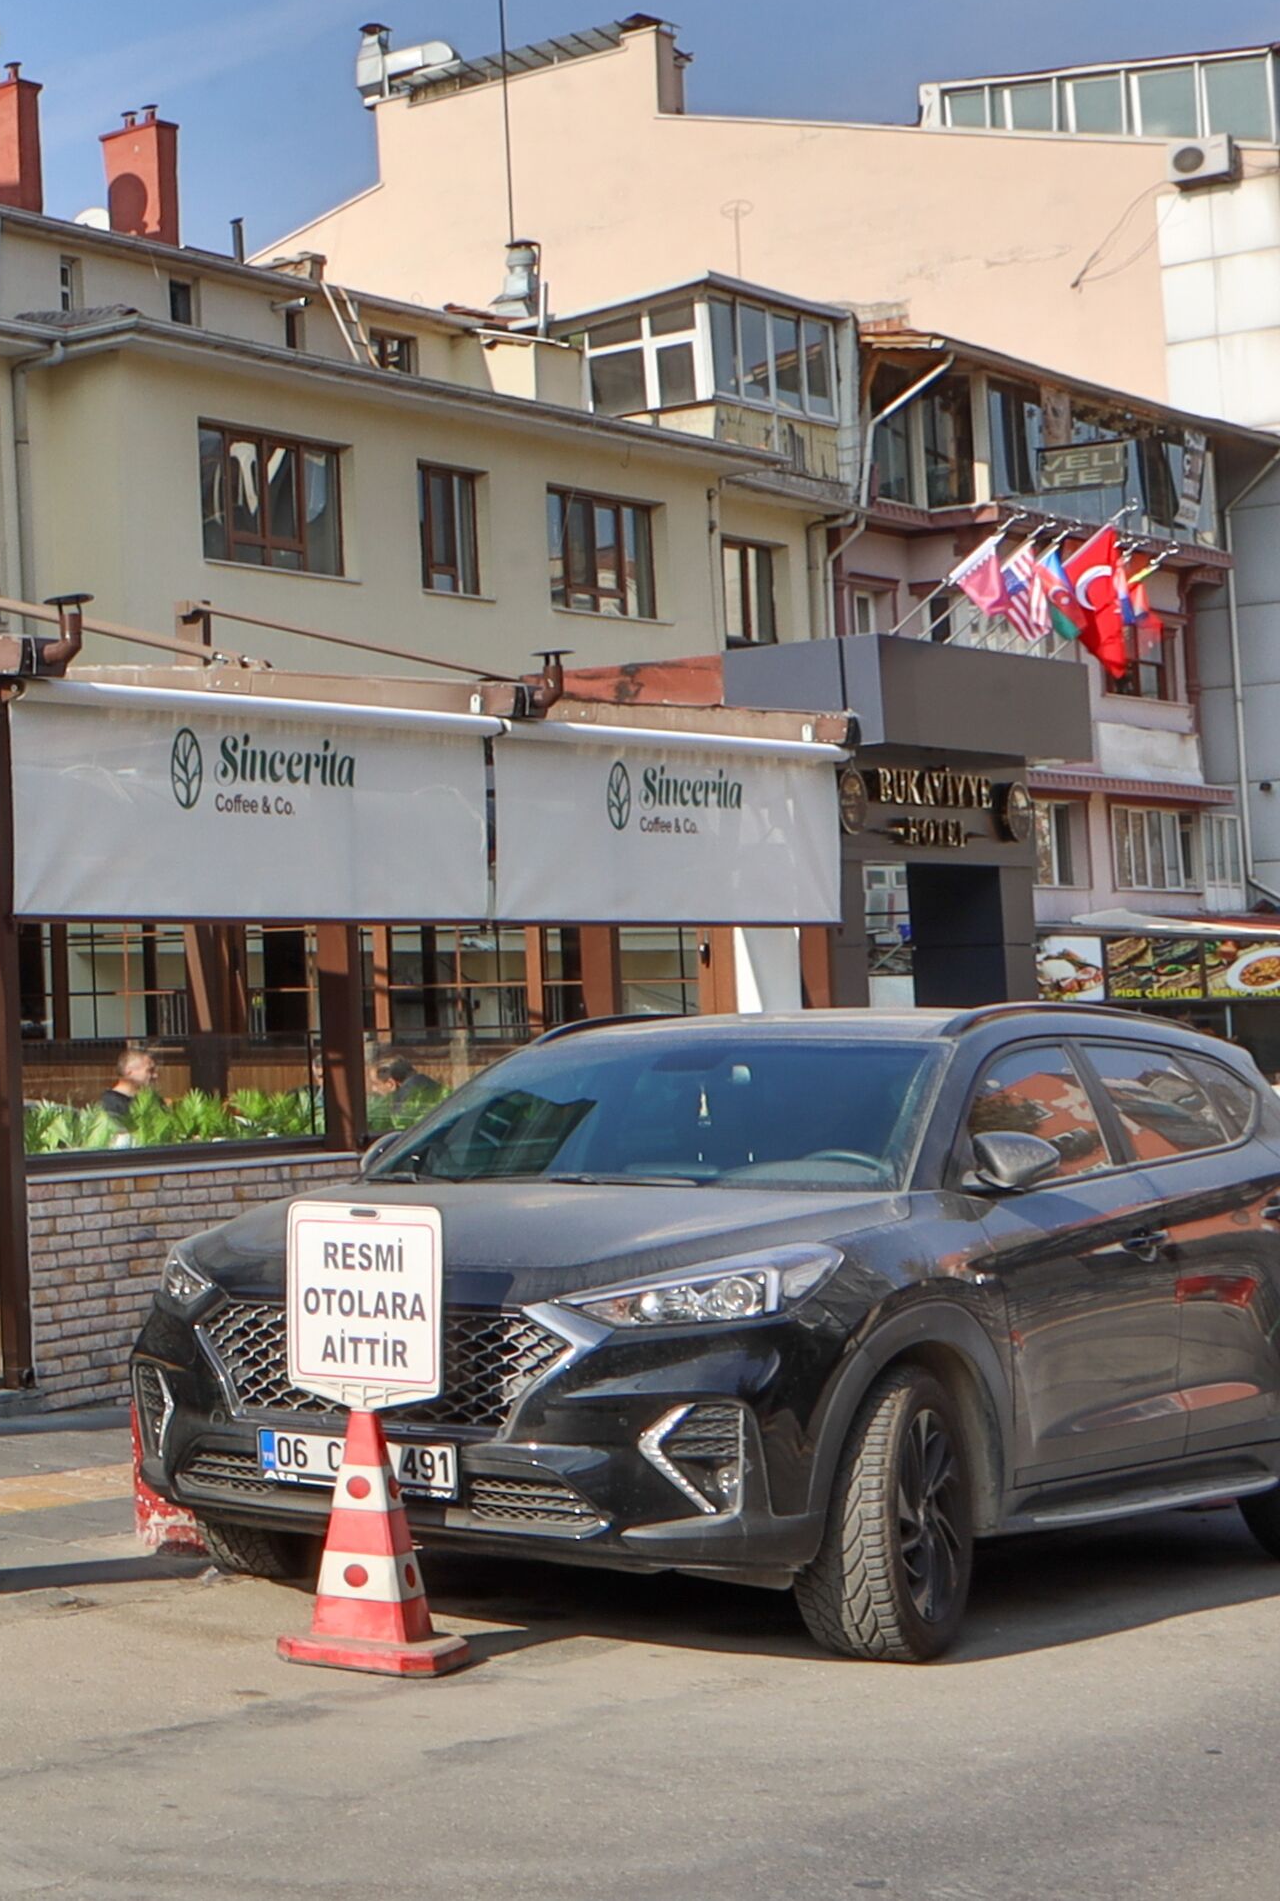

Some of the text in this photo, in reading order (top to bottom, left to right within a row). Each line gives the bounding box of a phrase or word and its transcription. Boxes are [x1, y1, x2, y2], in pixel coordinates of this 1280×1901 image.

[214, 733, 355, 788] Sincerita
[215, 793, 297, 815] Coffee & Co.
[640, 765, 743, 811] Sincerita
[878, 766, 993, 809] BUKAVİYYE
[640, 816, 699, 834] Coffee & Co.
[907, 815, 967, 848] HOTEL
[324, 1237, 403, 1273] RESMİ
[303, 1287, 427, 1322] OTOLARA
[321, 1328, 409, 1368] AİTTİR
[277, 1437, 308, 1468] 06
[402, 1447, 450, 1484] 491
